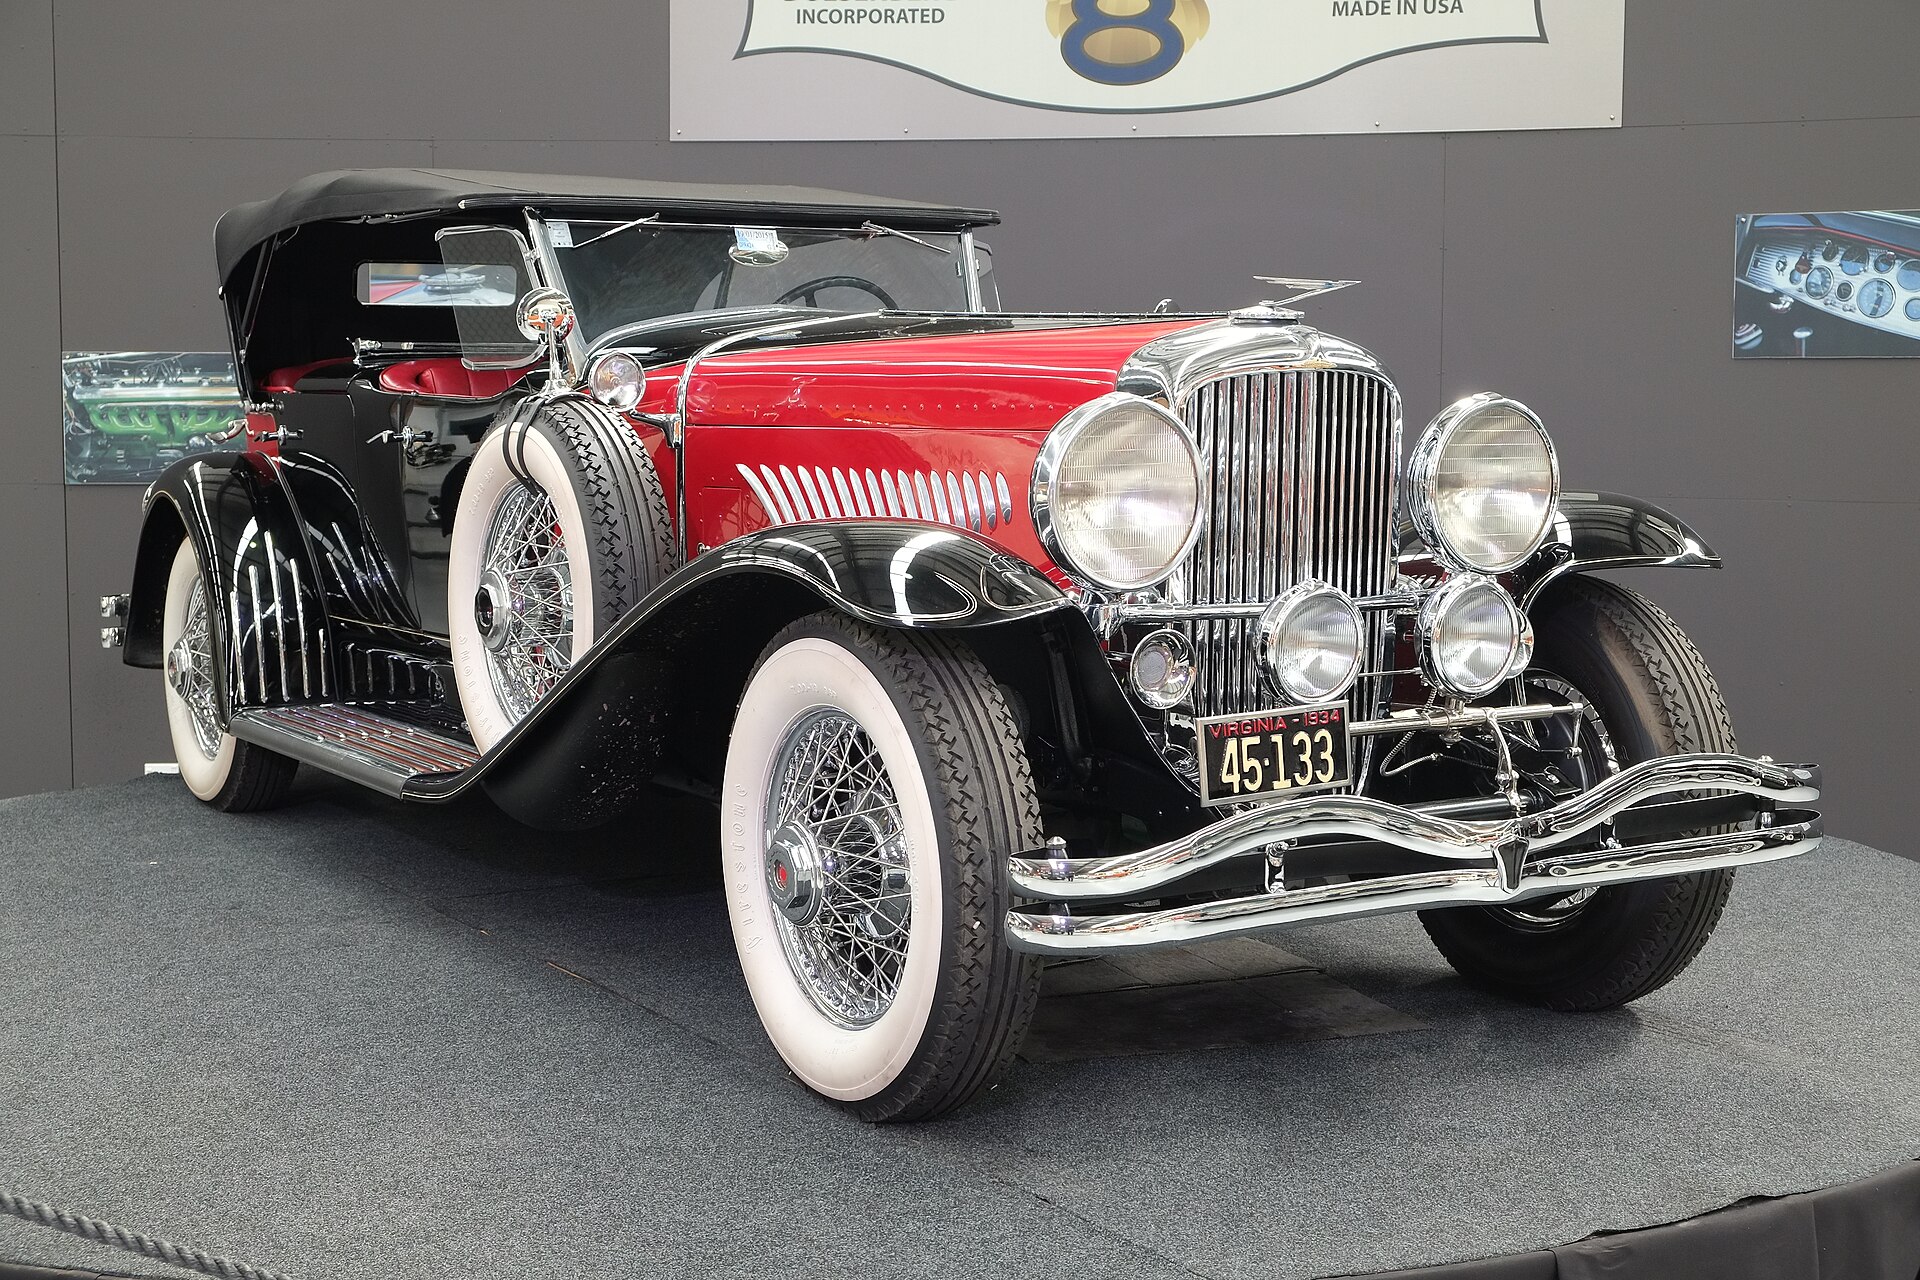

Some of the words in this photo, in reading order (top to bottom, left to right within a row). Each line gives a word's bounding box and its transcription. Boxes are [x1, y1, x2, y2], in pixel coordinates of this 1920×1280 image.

[796, 8, 945, 24] INCORPORATED
[1332, 0, 1391, 17] MADE
[1396, 0, 1417, 15] IN
[1423, 0, 1464, 14] USA
[1209, 716, 1288, 739] VIRGINIA
[1303, 709, 1341, 727] 1934
